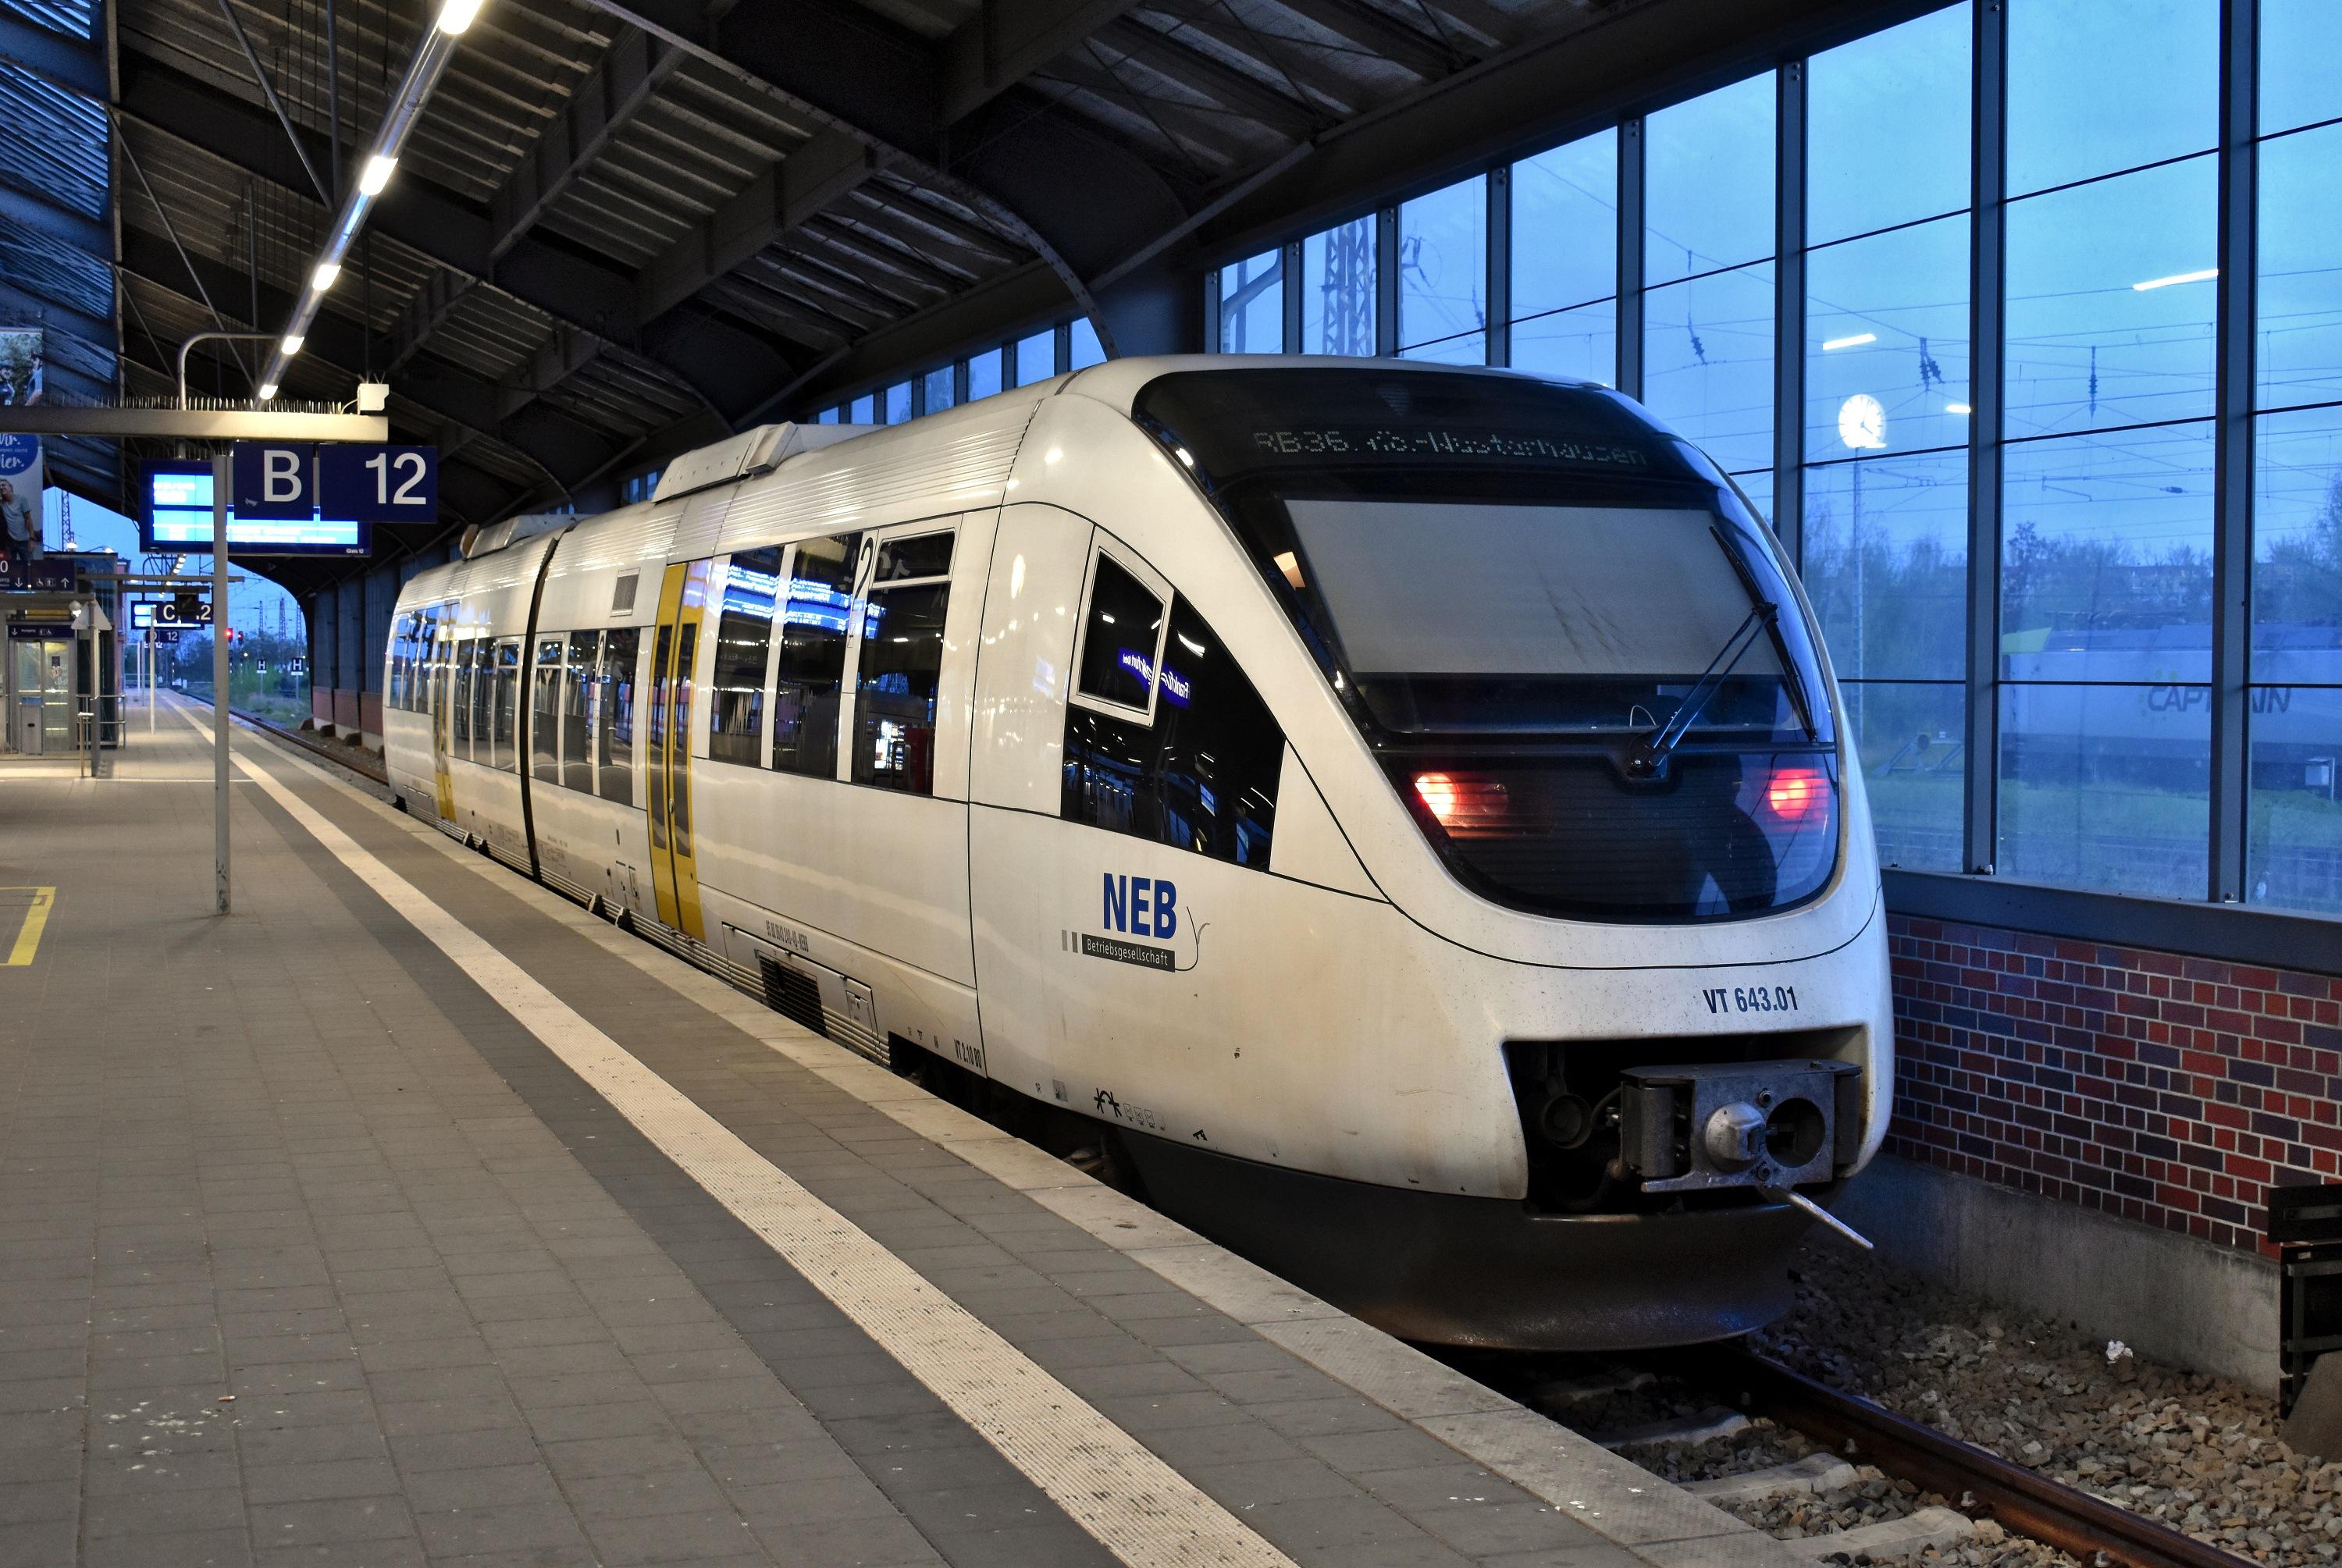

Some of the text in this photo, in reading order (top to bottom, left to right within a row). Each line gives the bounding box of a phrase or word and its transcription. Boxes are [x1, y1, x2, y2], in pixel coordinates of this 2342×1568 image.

[264, 450, 302, 502] B
[365, 453, 426, 505] 12
[163, 604, 176, 620] C
[167, 631, 178, 641] 12
[258, 660, 265, 670] H
[294, 659, 302, 671] H
[1103, 873, 1176, 940] NEB
[1087, 938, 1168, 965] Betriebsgesellschaft
[1702, 986, 1799, 1014] VT 643.01
